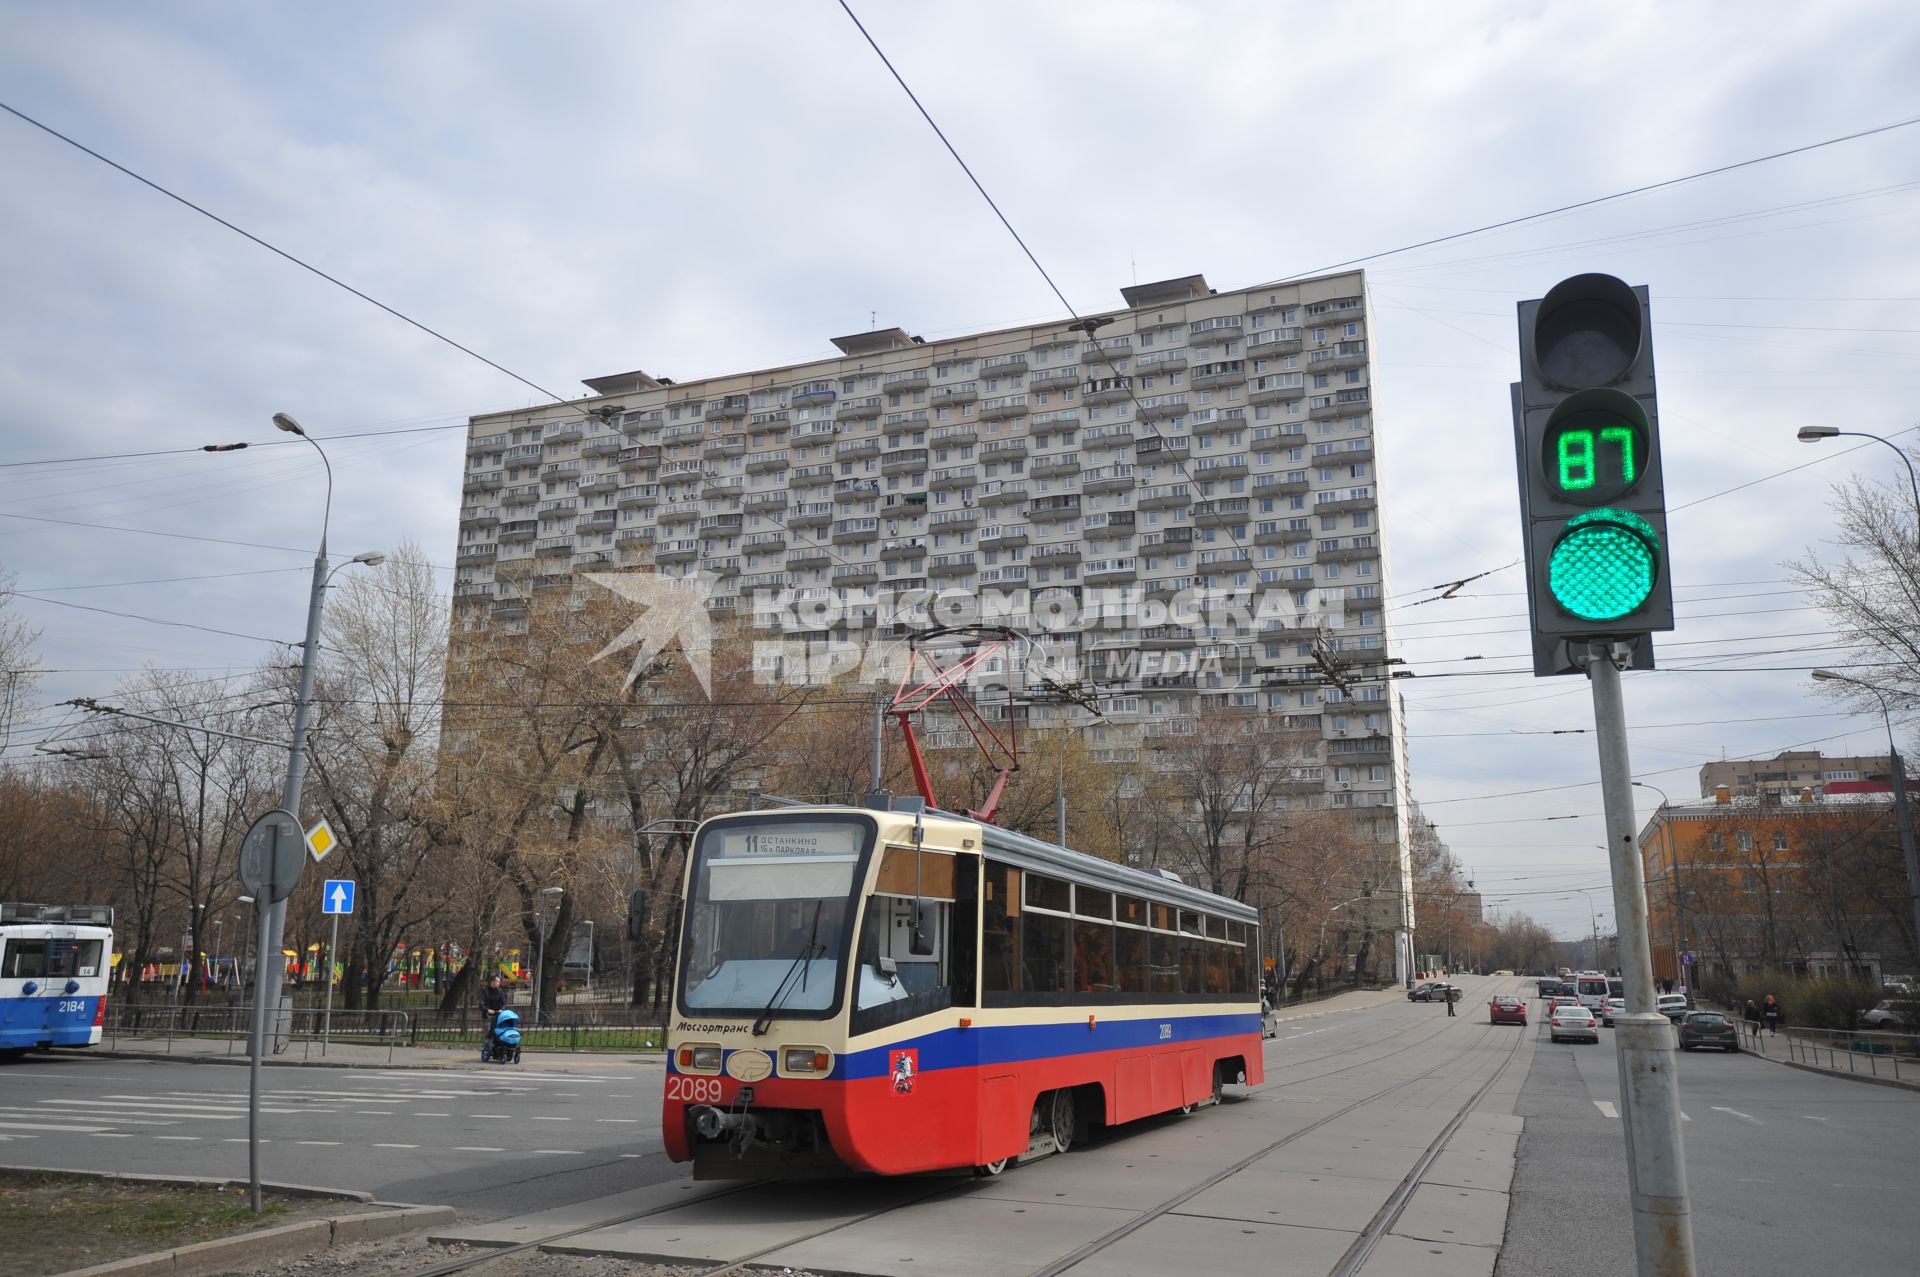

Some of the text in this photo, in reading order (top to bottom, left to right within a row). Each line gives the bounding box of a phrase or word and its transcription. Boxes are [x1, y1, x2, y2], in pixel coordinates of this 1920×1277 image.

[1559, 427, 1634, 490] 87
[745, 835, 758, 853] 11
[760, 836, 817, 846] ОСТАНКИНО
[59, 1001, 85, 1012] 2184
[676, 1022, 749, 1034] Мосгортранс
[1159, 1023, 1172, 1040] 2089
[667, 1076, 722, 1103] 2089
